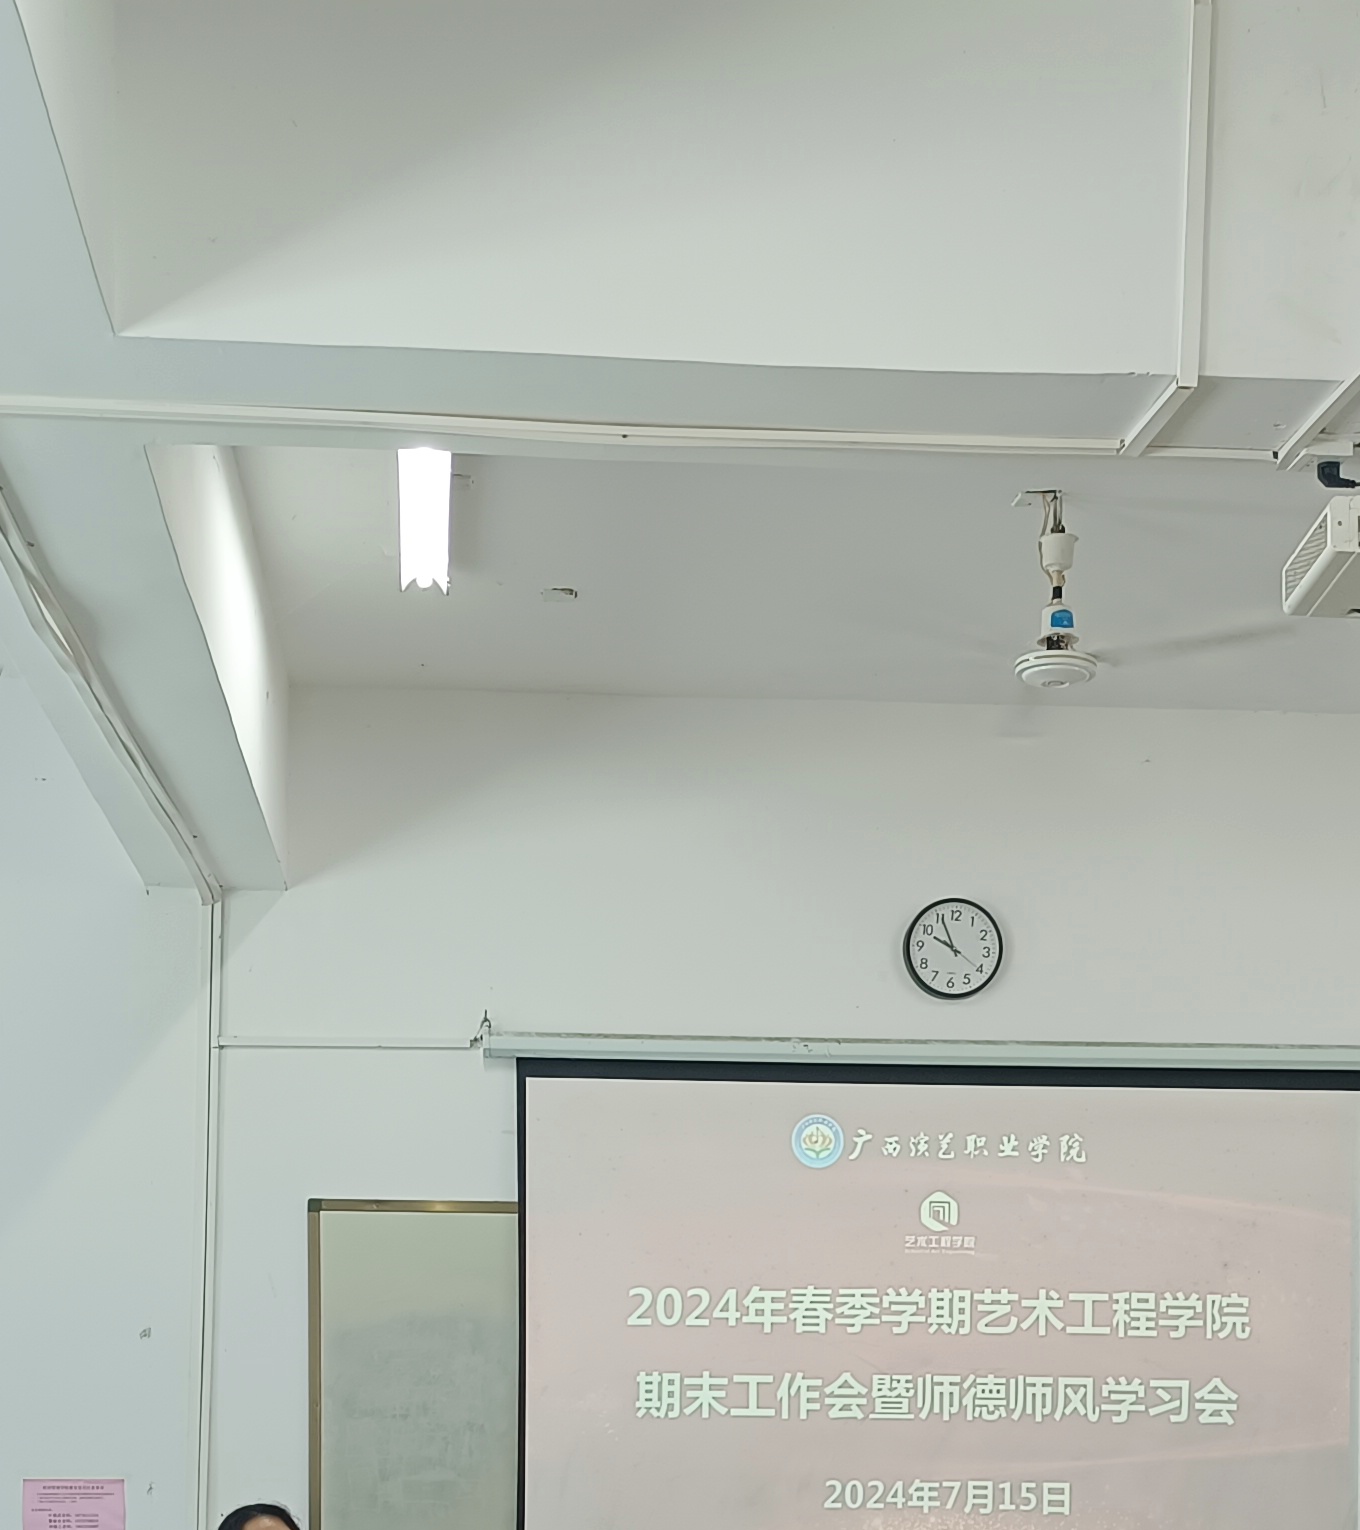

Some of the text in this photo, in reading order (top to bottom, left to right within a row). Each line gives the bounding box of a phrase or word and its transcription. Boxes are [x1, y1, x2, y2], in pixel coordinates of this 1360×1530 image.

[950, 910, 962, 921] 12
[970, 916, 974, 928] 1
[922, 924, 933, 936] 10
[980, 929, 988, 941] 2
[916, 940, 924, 952] 9
[982, 946, 990, 958] 3
[920, 958, 928, 969] 8
[976, 964, 984, 974] 4
[931, 970, 939, 982] 7
[962, 974, 971, 984] 5
[946, 977, 954, 988] 6
[848, 1129, 1087, 1163] 广西演艺职业学院
[626, 1286, 1252, 1341] 2024年春季学期艺术工程学院
[634, 1371, 1240, 1427] 期末工作会暨师德师风学习会
[823, 1479, 1073, 1517] 2024年7月15日
